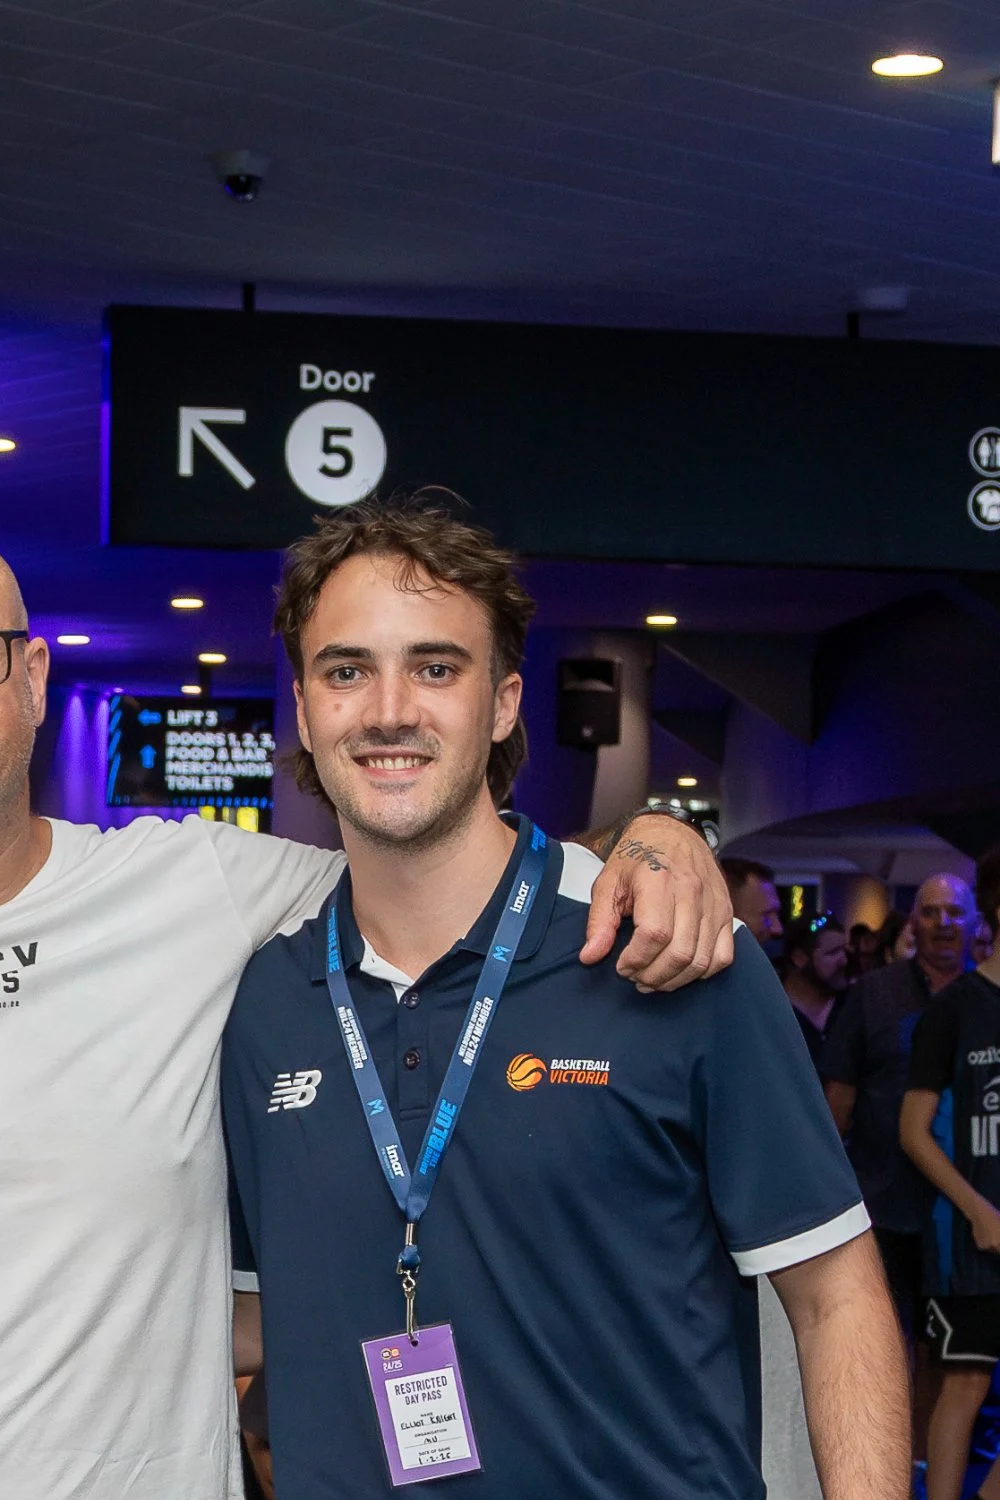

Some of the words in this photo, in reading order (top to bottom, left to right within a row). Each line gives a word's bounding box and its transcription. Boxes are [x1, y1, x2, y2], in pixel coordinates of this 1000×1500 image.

[300, 364, 375, 393] Door
[318, 426, 353, 478] 5
[167, 709, 204, 726] LIFT
[205, 709, 218, 727] 3
[166, 731, 227, 747] DOORS
[166, 747, 215, 761] FOOD
[230, 747, 268, 762] BAR
[166, 776, 235, 792] TOILETS
[462, 1034, 480, 1066] NBL24
[472, 996, 493, 1037] MEMBER
[345, 1032, 363, 1069] MEMBER
[551, 1059, 610, 1071] BASKETBALL
[550, 1070, 609, 1085] VICTORIA
[427, 1098, 457, 1152] BLUE
[385, 1143, 404, 1175] imar
[394, 1375, 448, 1396] RESTRICTED
[405, 1395, 419, 1406] DAY
[422, 1390, 442, 1402] PASS
